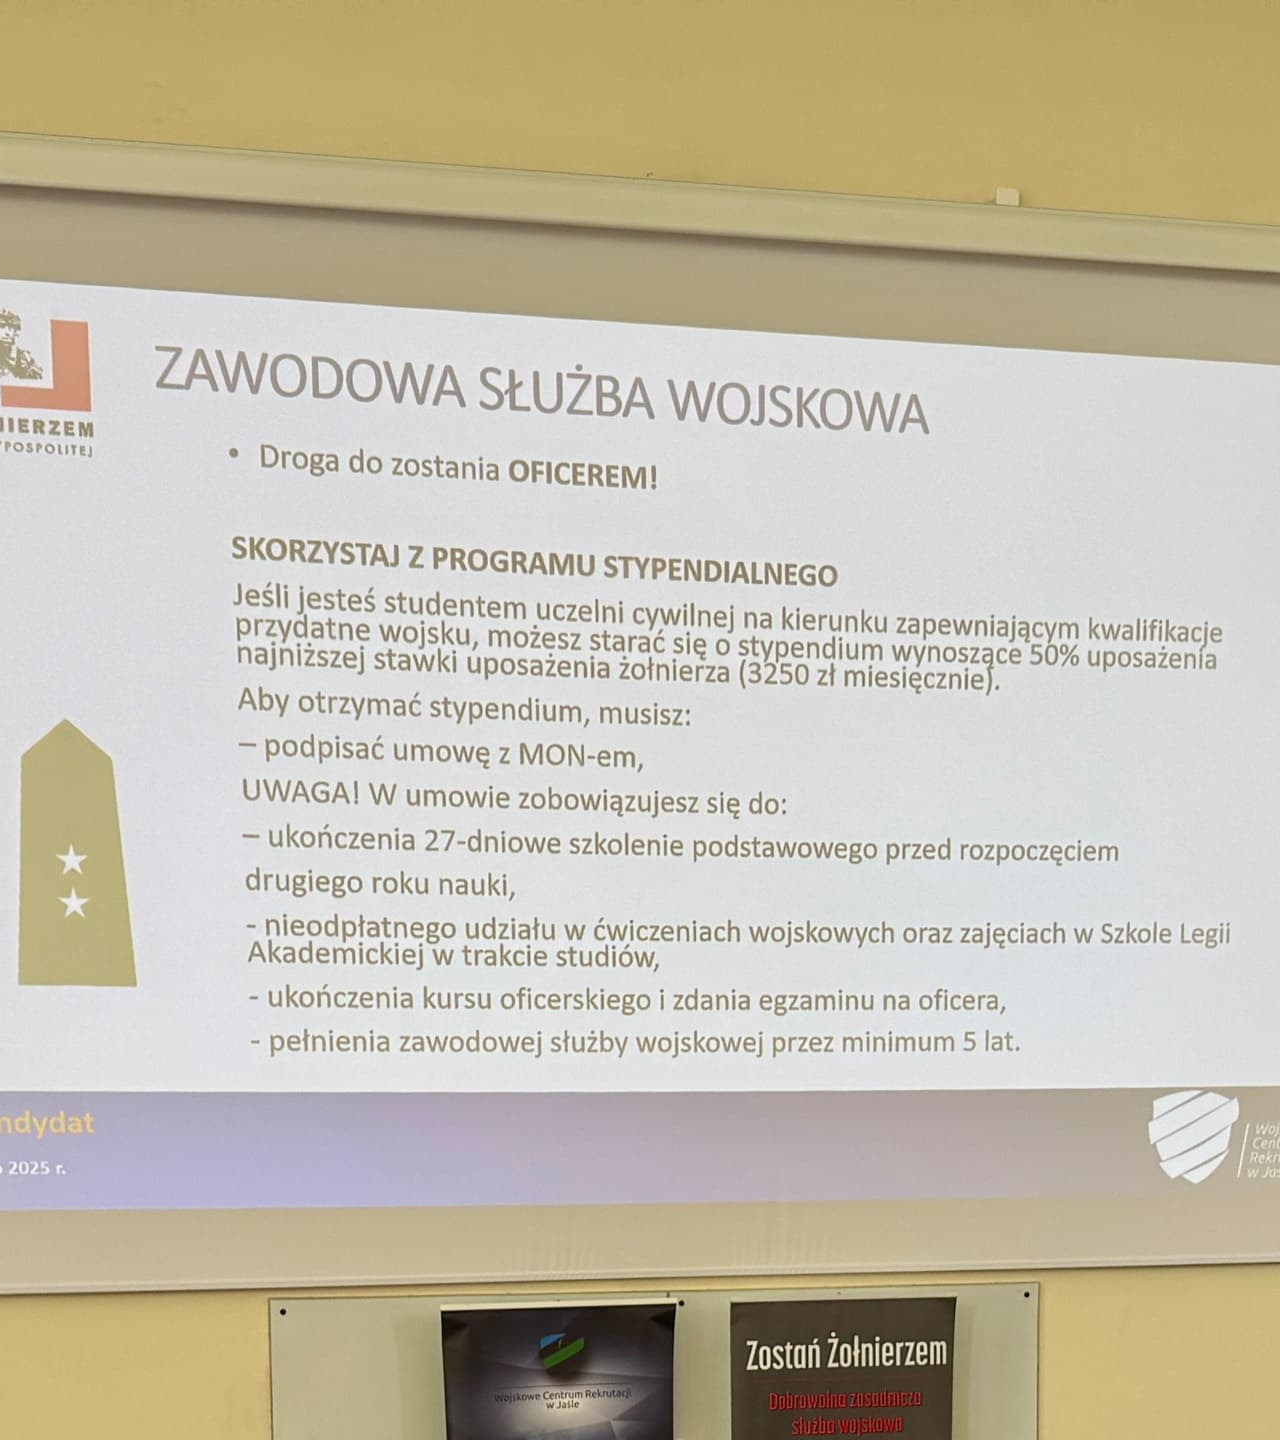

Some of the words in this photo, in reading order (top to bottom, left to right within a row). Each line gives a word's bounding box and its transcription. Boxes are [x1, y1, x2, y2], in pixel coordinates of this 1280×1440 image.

[154, 345, 467, 409] ZAWODOWA
[479, 363, 656, 420] SŁUŻBA
[666, 378, 930, 435] WOJSKOWA
[260, 443, 340, 478] Droga
[348, 447, 384, 475] do
[391, 455, 500, 482] zostania
[508, 459, 657, 491] OFICEREM!
[231, 535, 400, 568] SKORZYSTAJ
[407, 544, 425, 569] Z
[432, 546, 596, 577] PROGRAMU
[603, 555, 839, 588] STYPENDIALNEGO
[232, 582, 289, 609] Jeśli
[299, 584, 377, 616] jesteś
[383, 590, 527, 621] studentem
[536, 597, 624, 625] uczelni
[632, 601, 735, 635] cywilnej
[743, 610, 773, 630] na
[781, 605, 888, 634] kierunku
[896, 613, 1080, 645] zapewniającym
[1088, 616, 1223, 644] kwalifikacje
[235, 613, 371, 648] przydatne
[378, 619, 479, 652] wojsku,
[487, 624, 582, 651] możesz
[589, 628, 666, 654] starać
[672, 631, 708, 662] się
[715, 637, 731, 657] o
[737, 635, 884, 664] stypendium
[891, 643, 1022, 669] wynoszące
[1029, 643, 1080, 668] 50%
[1087, 645, 1217, 673] uposażenia
[237, 640, 365, 676] najniższej
[373, 647, 457, 674] stawki
[466, 652, 611, 681] uposażenia
[618, 655, 730, 684] żołnierza
[739, 658, 810, 690] (3250
[816, 661, 837, 687] zł
[843, 664, 1000, 695] miesięcznie).
[237, 685, 290, 719] Aby
[297, 690, 422, 721] otrzymać
[429, 695, 590, 729] stypendium,
[599, 701, 691, 727] musisz:
[264, 732, 385, 765] podpisać
[393, 742, 491, 770] umowę
[498, 746, 511, 765] z
[519, 741, 644, 774] MON-em,
[242, 777, 359, 806] UWAGA!
[368, 781, 398, 806] W
[405, 784, 511, 810] umowie
[518, 785, 700, 819] zobowiązujesz
[706, 791, 741, 820] się
[748, 790, 787, 816] do:
[268, 823, 416, 852] ukończenia
[424, 828, 562, 855] 27-dniowe
[569, 831, 684, 857] szkolenie
[692, 833, 878, 865] podstawowego
[886, 836, 952, 866] przed
[960, 839, 1119, 867] rozpoczęciem
[245, 866, 364, 899] drugiego
[371, 869, 429, 896] roku
[439, 871, 516, 902] nauki,
[265, 912, 457, 945] nieodpłatnego
[465, 915, 556, 941] udziału
[563, 923, 587, 942] w
[593, 916, 741, 944] ćwiczeniach
[748, 919, 895, 949] wojskowych
[902, 926, 953, 945] oraz
[959, 921, 1066, 950] zajęciach
[1073, 927, 1094, 945] w
[1100, 921, 1172, 945] Szkole
[1180, 921, 1231, 950] Legii
[247, 938, 424, 972] Akademickiej
[431, 948, 455, 967] w
[460, 942, 548, 968] trakcie
[555, 943, 660, 973] studiów,
[267, 983, 414, 1009] ukończenia
[423, 985, 492, 1010] kursu
[499, 986, 652, 1017] oficerskiego
[659, 988, 665, 1011] i
[672, 987, 751, 1012] zdania
[758, 988, 875, 1017] egzaminu
[882, 994, 911, 1012] na
[918, 987, 1006, 1016] oficera,
[269, 1027, 391, 1058] pełnienia
[399, 1028, 542, 1059] zawodowej
[550, 1029, 629, 1059] służby
[635, 1029, 764, 1059] wojskowej
[772, 1035, 835, 1059] przez
[842, 1030, 955, 1053] minimum
[962, 1031, 977, 1052] 5
[984, 1028, 1021, 1052] lat.
[8, 1160, 51, 1176] 2025
[55, 1163, 67, 1176] r.
[1247, 1167, 1260, 1179] w
[745, 1338, 821, 1371] Zostań
[827, 1331, 947, 1368] Żołnierzem
[494, 1392, 541, 1404] Wojskowe
[542, 1390, 583, 1401] Centrum
[585, 1387, 632, 1401] Rekrutacji
[546, 1401, 555, 1409] w
[768, 1389, 846, 1411] Dobrowolna
[849, 1387, 922, 1409] zasadnicza
[791, 1416, 836, 1436] służba
[839, 1415, 904, 1439] wojskowa
